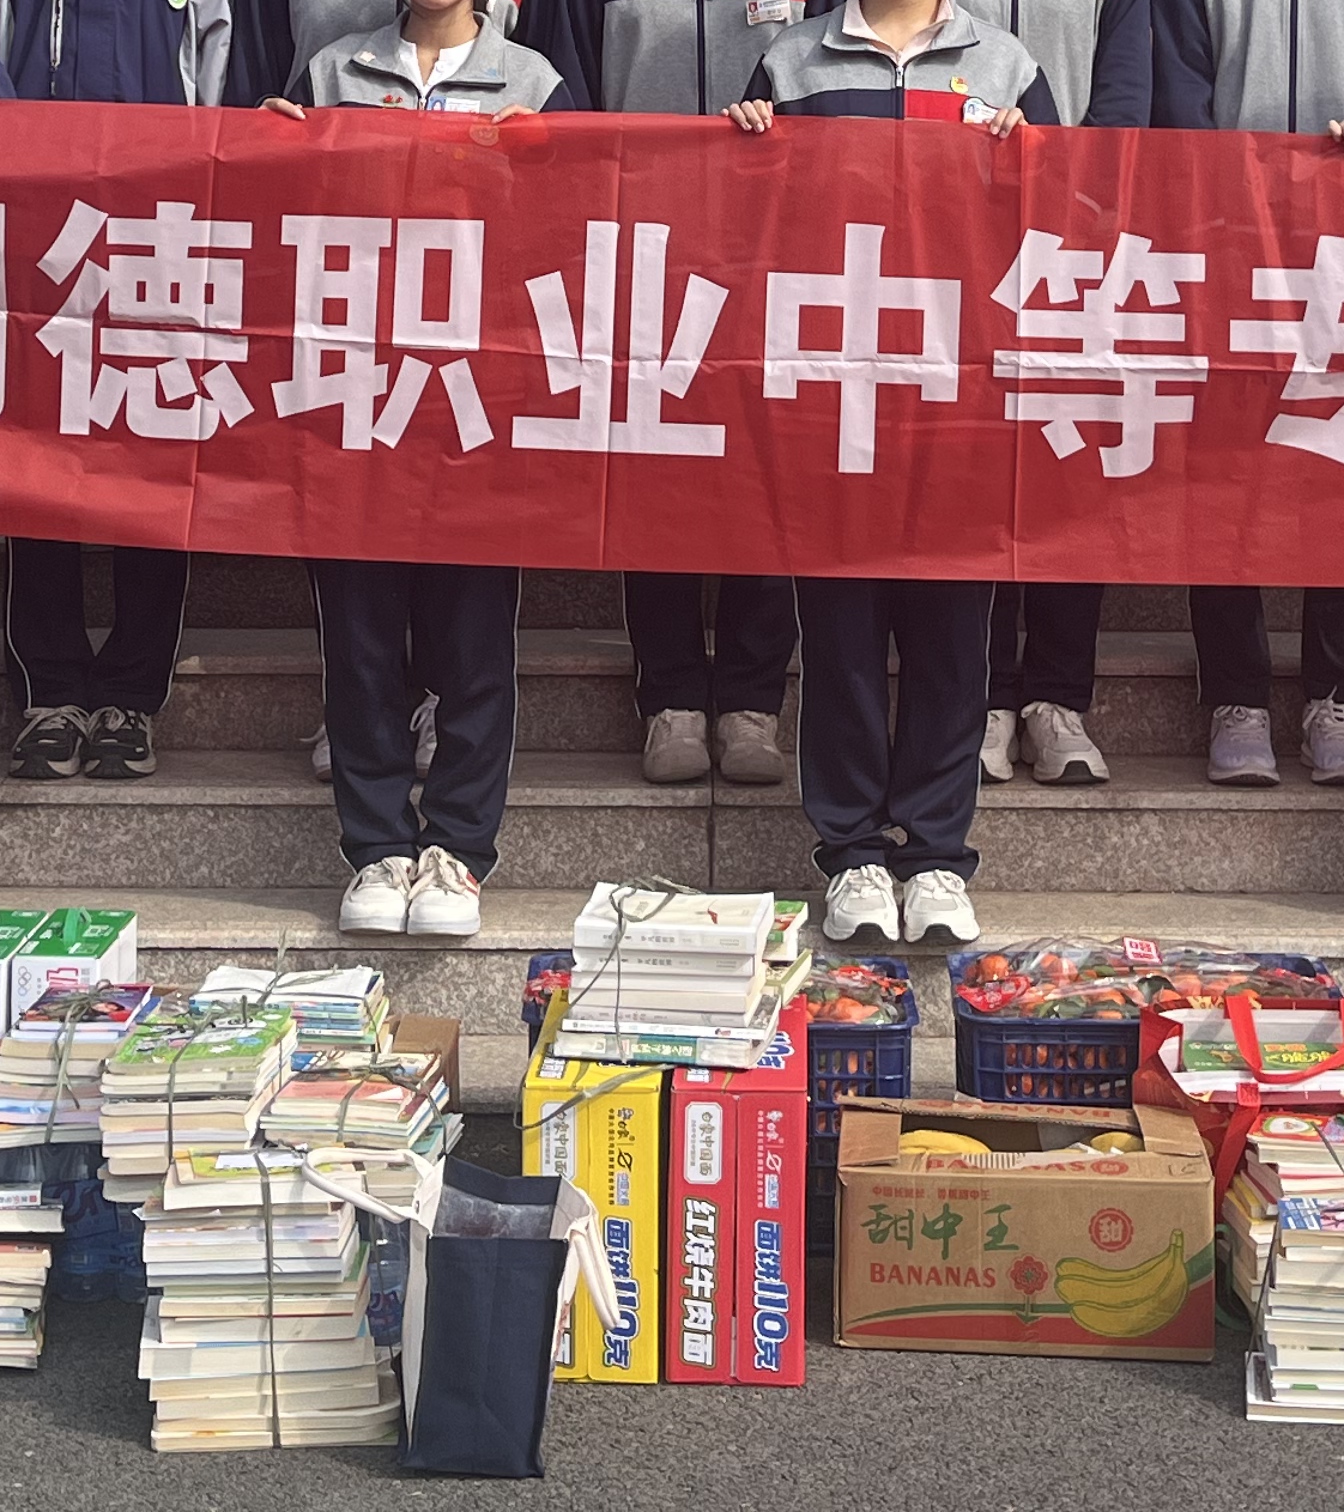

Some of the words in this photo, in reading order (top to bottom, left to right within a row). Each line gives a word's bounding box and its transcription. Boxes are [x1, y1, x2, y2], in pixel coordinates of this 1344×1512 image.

[699, 1111, 715, 1176] 白象中国面
[683, 1199, 716, 1366] 红烧牛肉面
[860, 1202, 1020, 1261] 甜中王
[869, 1262, 997, 1289] BANANAS
[605, 1218, 639, 1368] 面饼110克
[755, 1220, 789, 1371] 面饼110克
